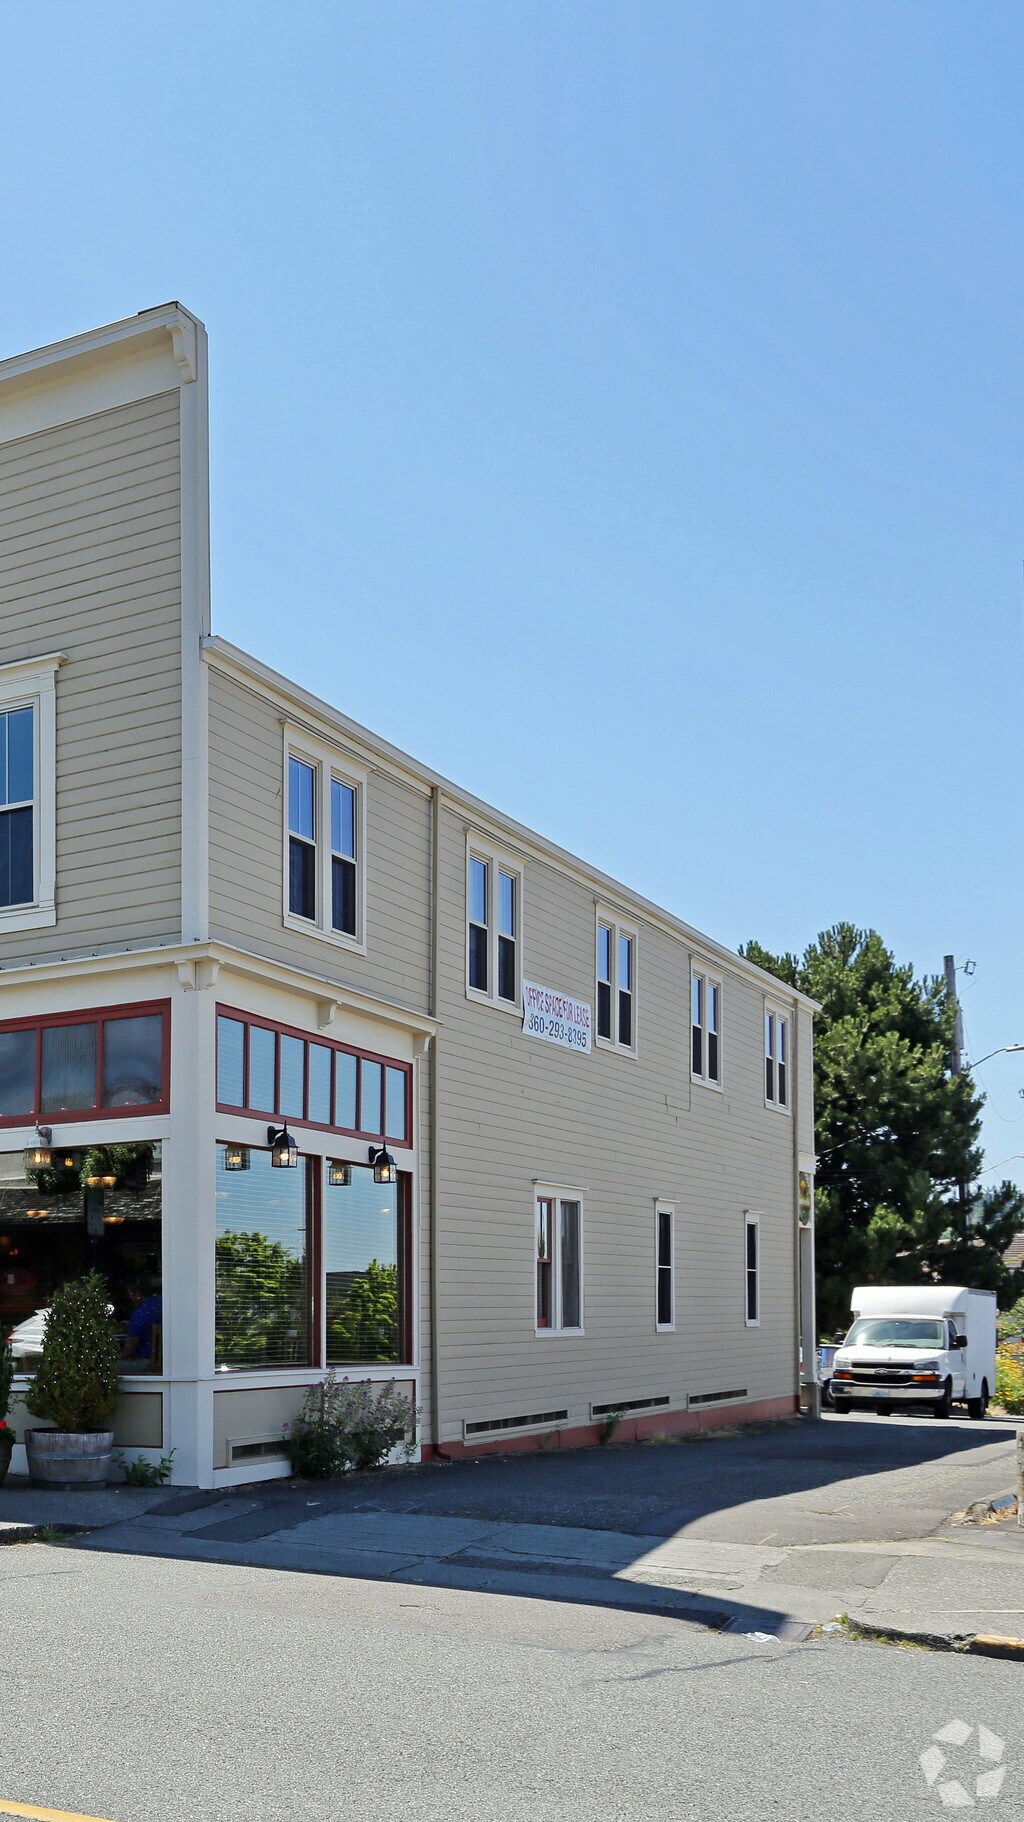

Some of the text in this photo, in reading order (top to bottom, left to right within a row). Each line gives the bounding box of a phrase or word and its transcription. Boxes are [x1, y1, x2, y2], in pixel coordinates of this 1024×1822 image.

[545, 993, 563, 1018] SPACE
[562, 1000, 574, 1022] FOR
[573, 1005, 590, 1028] LEASE
[528, 1013, 587, 1048] 360-293-8395
